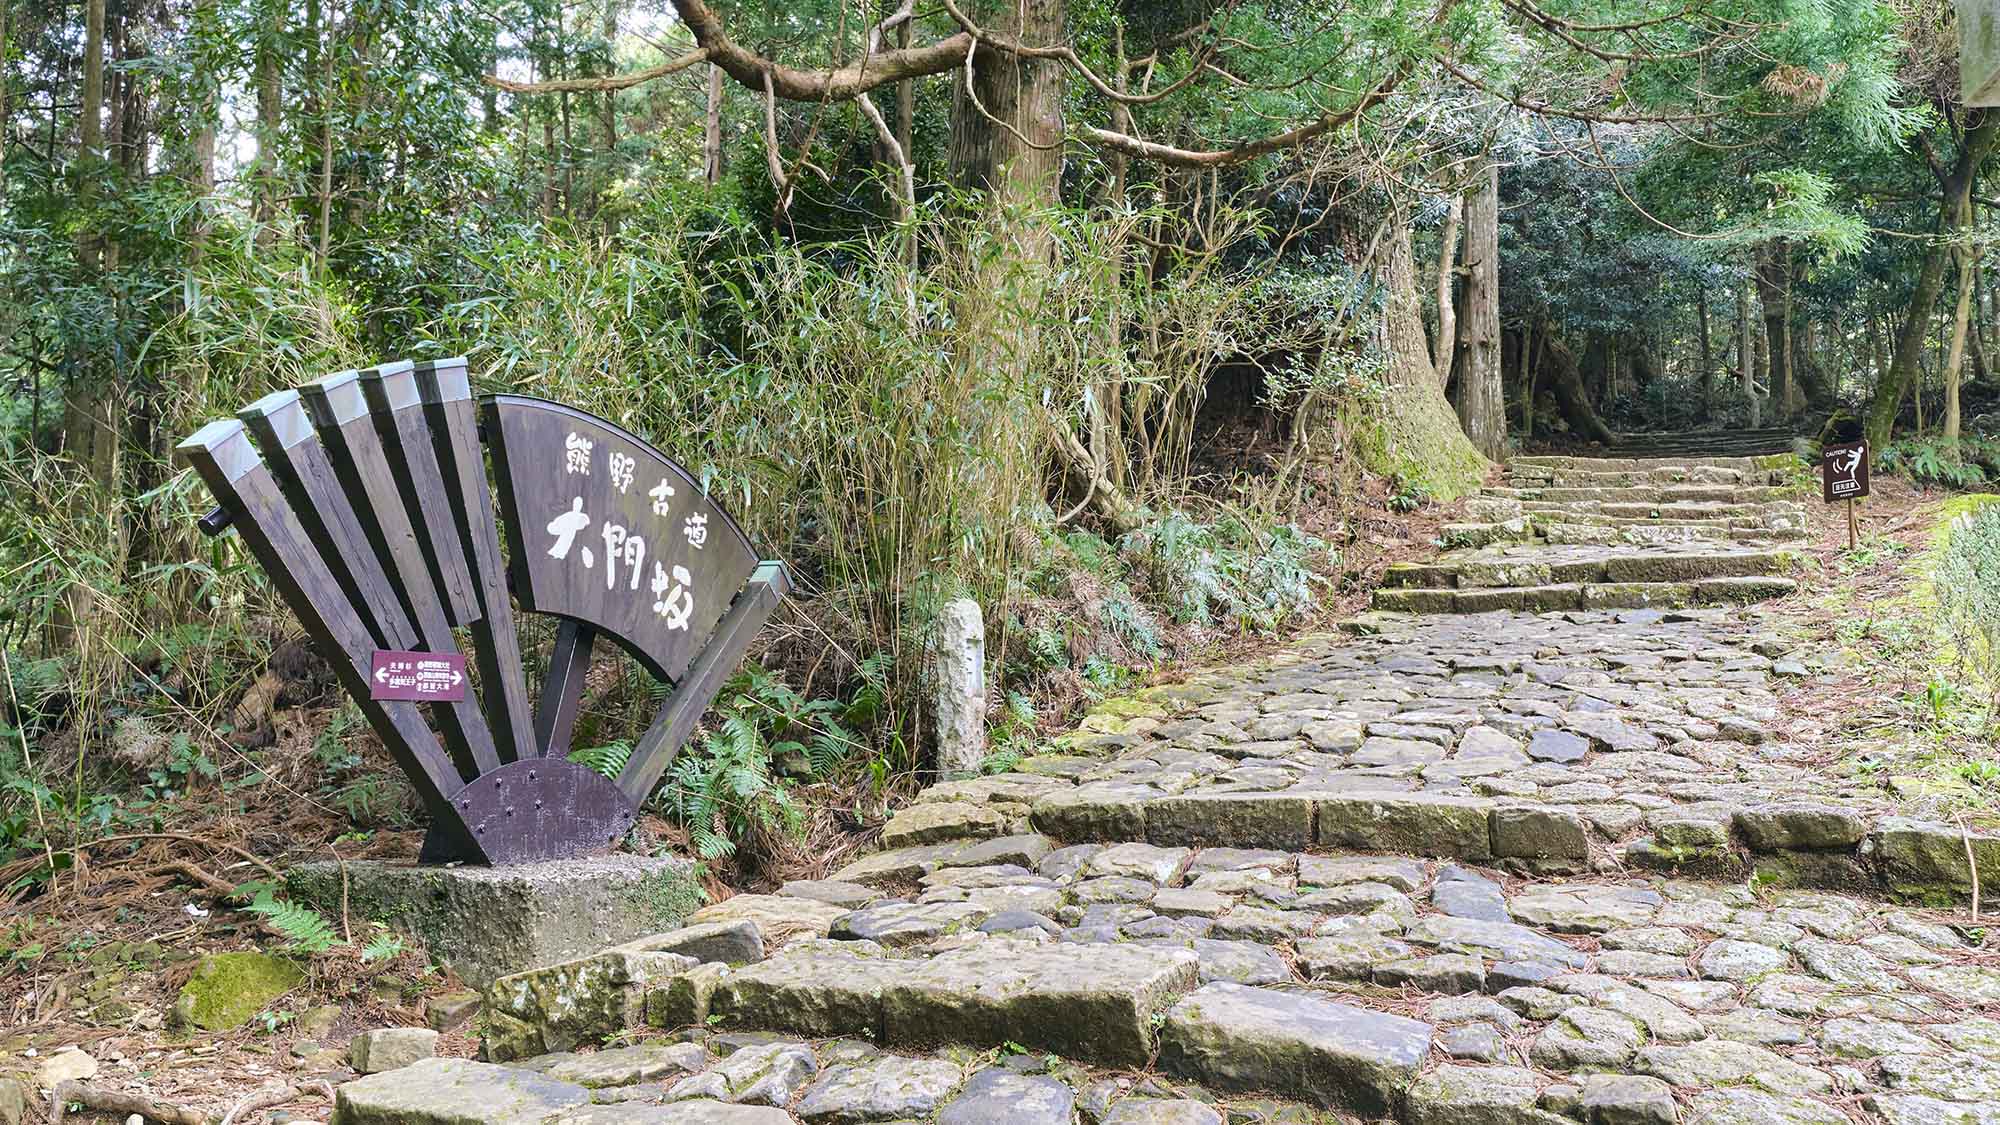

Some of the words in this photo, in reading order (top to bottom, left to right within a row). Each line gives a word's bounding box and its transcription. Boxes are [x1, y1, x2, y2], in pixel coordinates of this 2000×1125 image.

[565, 431, 708, 549] 熊野古道
[546, 496, 694, 631] 大門坂
